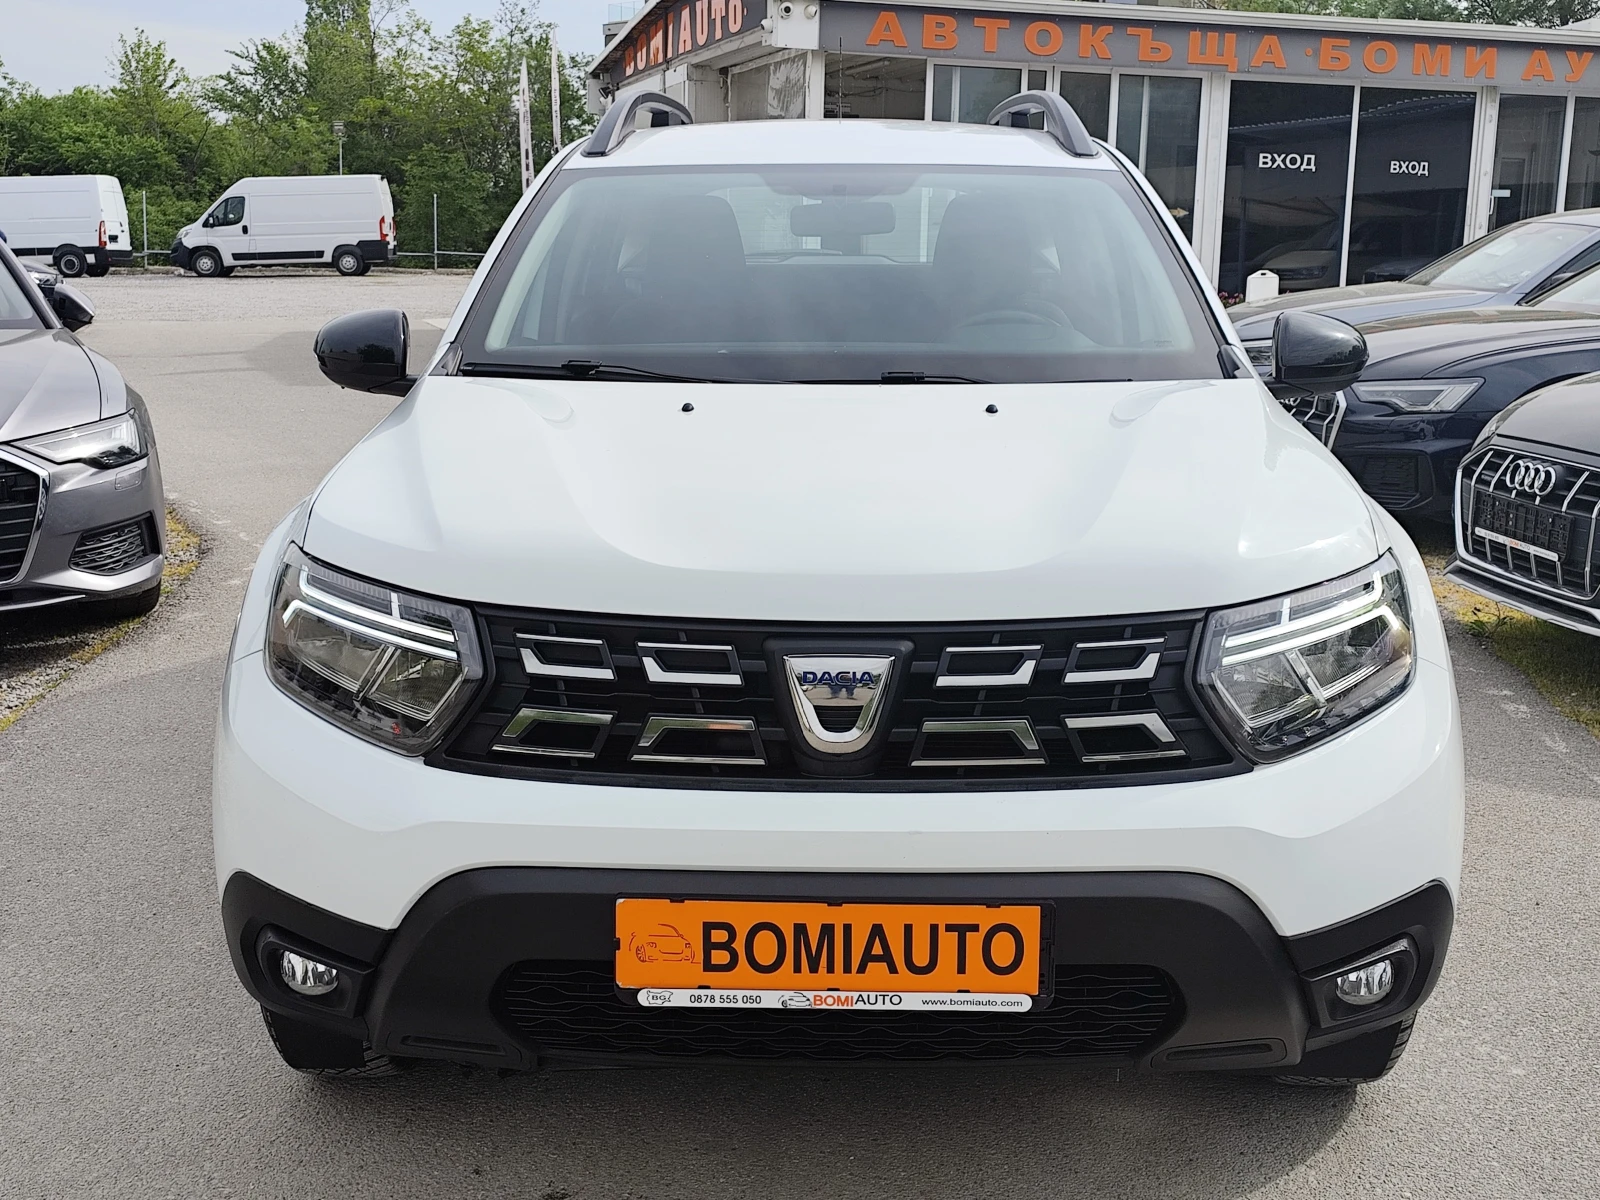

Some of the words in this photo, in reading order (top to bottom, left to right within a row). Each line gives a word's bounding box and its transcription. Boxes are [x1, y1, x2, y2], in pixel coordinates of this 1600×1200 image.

[866, 11, 1287, 72] АВТОКЪЩА
[1258, 153, 1316, 172] ВХОД
[1390, 160, 1429, 177] ВХОД
[802, 671, 875, 684] DACIA
[702, 921, 1025, 976] BOMIAUTO
[689, 994, 716, 1004] 0878
[719, 994, 738, 1004] 555
[741, 995, 762, 1005] 050
[921, 997, 1023, 1007] www.bomiauto.com
